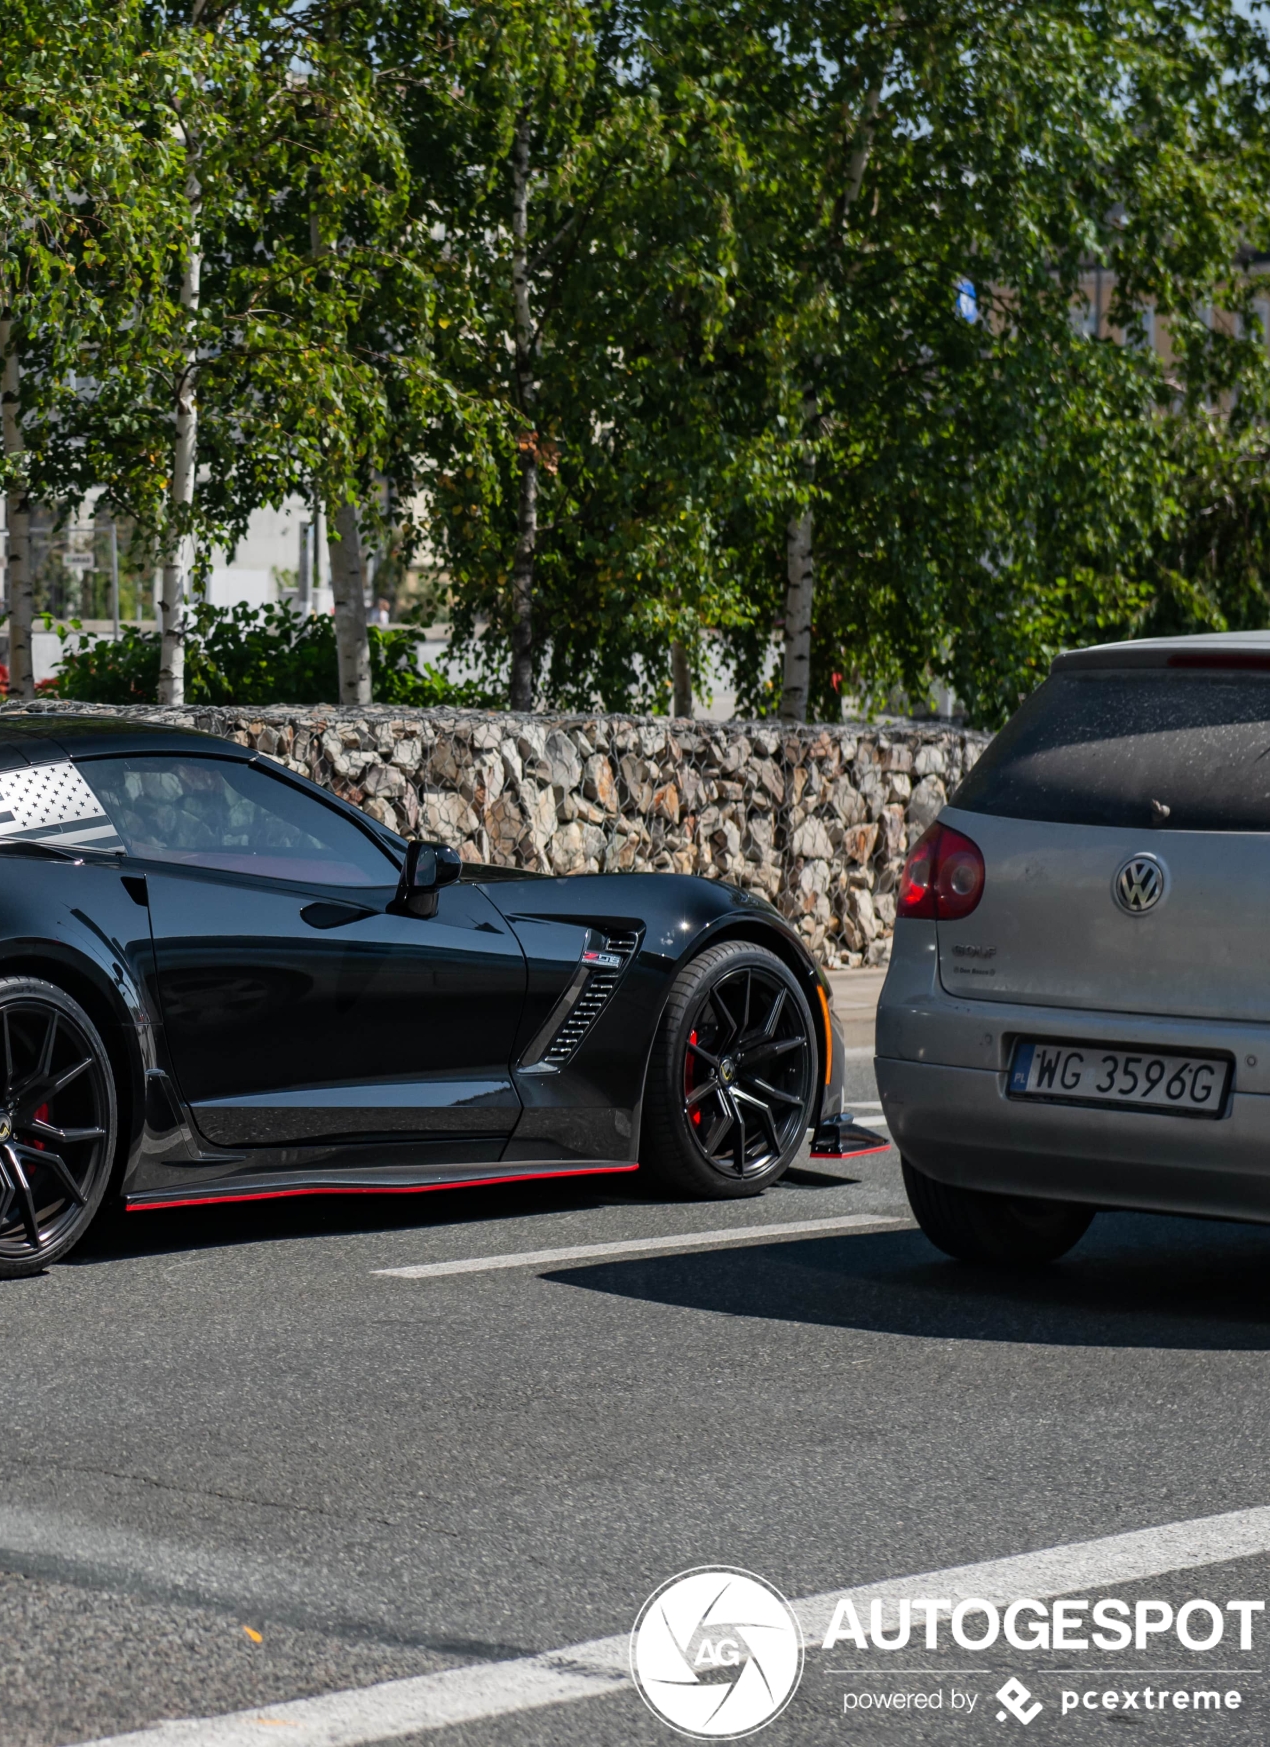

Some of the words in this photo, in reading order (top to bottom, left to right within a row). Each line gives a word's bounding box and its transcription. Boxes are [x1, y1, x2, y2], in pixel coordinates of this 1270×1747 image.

[1014, 1072, 1025, 1084] PL
[1036, 1050, 1084, 1090] WG
[1096, 1055, 1215, 1103] 3596G
